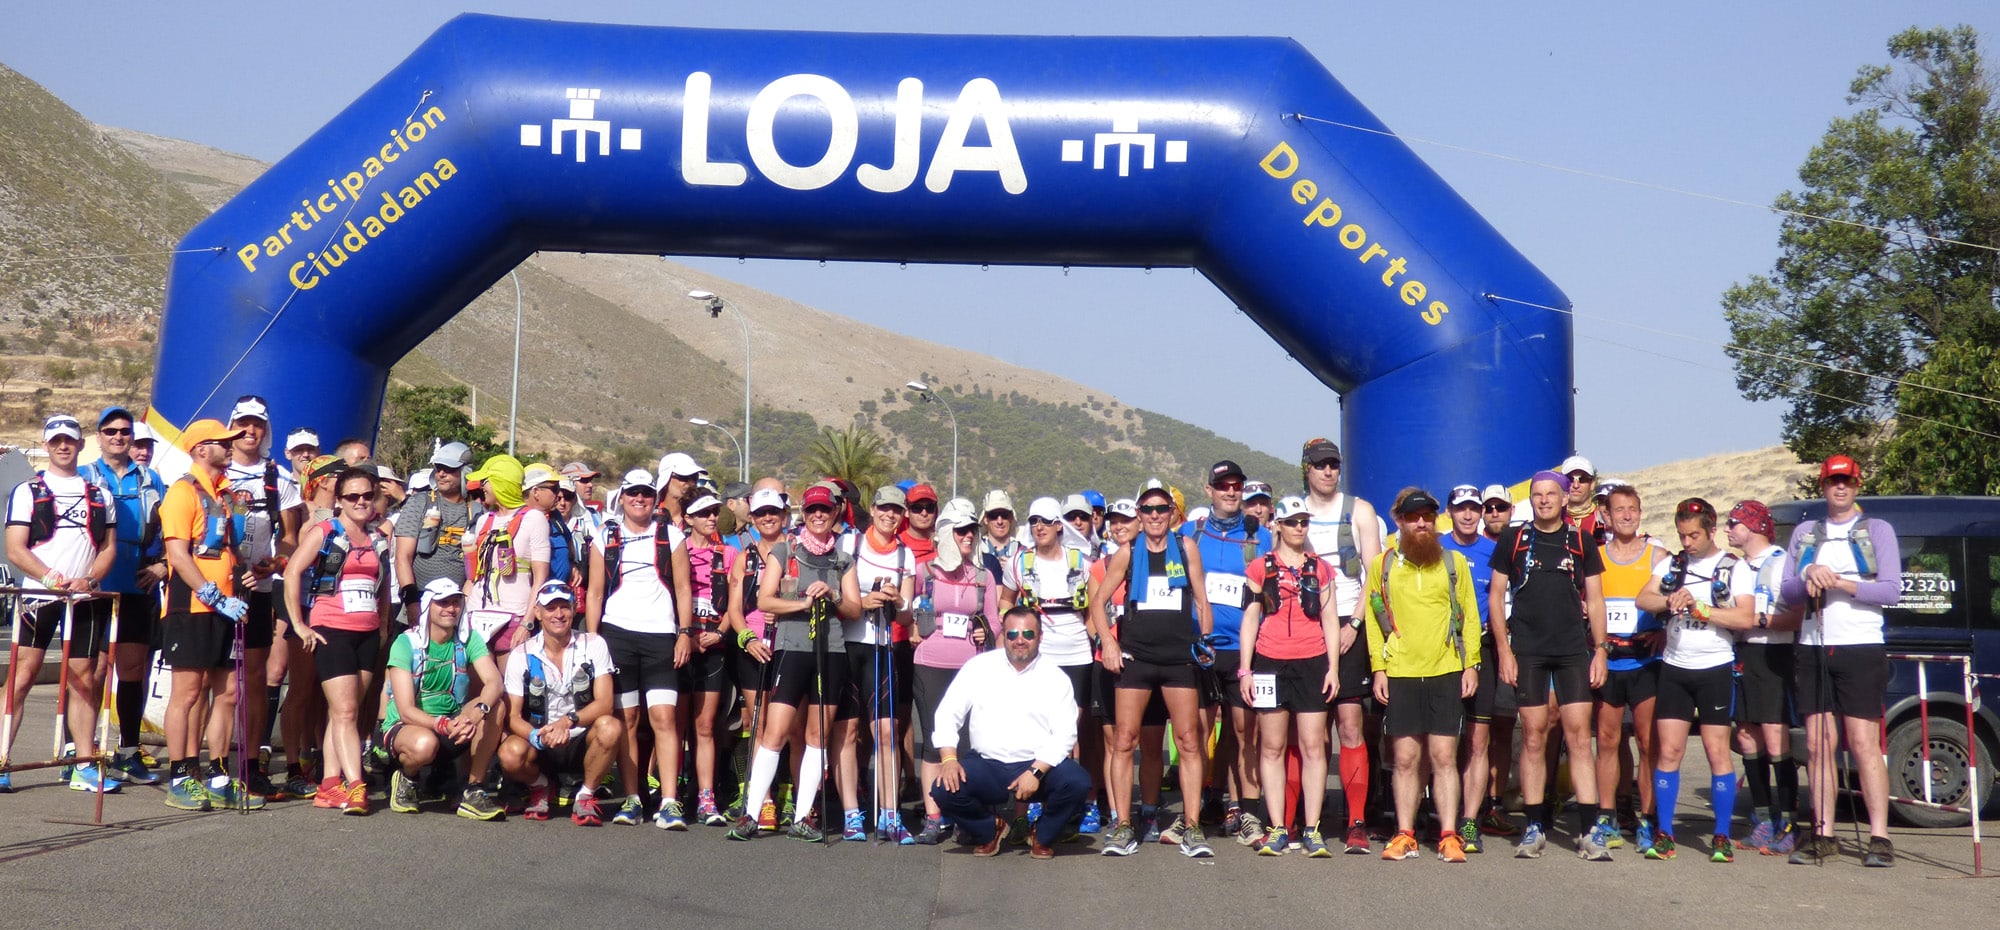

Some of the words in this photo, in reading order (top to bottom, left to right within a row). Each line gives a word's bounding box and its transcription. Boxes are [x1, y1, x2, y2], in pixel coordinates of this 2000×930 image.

[682, 71, 1028, 195] LOJA
[237, 105, 447, 273] Participación
[288, 157, 458, 290] Ciudadana
[1258, 140, 1449, 326] Deportes
[1152, 587, 1174, 597] 162
[1219, 583, 1238, 595] 141
[1918, 580, 1936, 592] 32
[1940, 580, 1956, 592] 01
[946, 616, 968, 625] 127
[1608, 612, 1628, 621] 121
[1685, 620, 1708, 630] 142
[1255, 686, 1274, 695] 113
